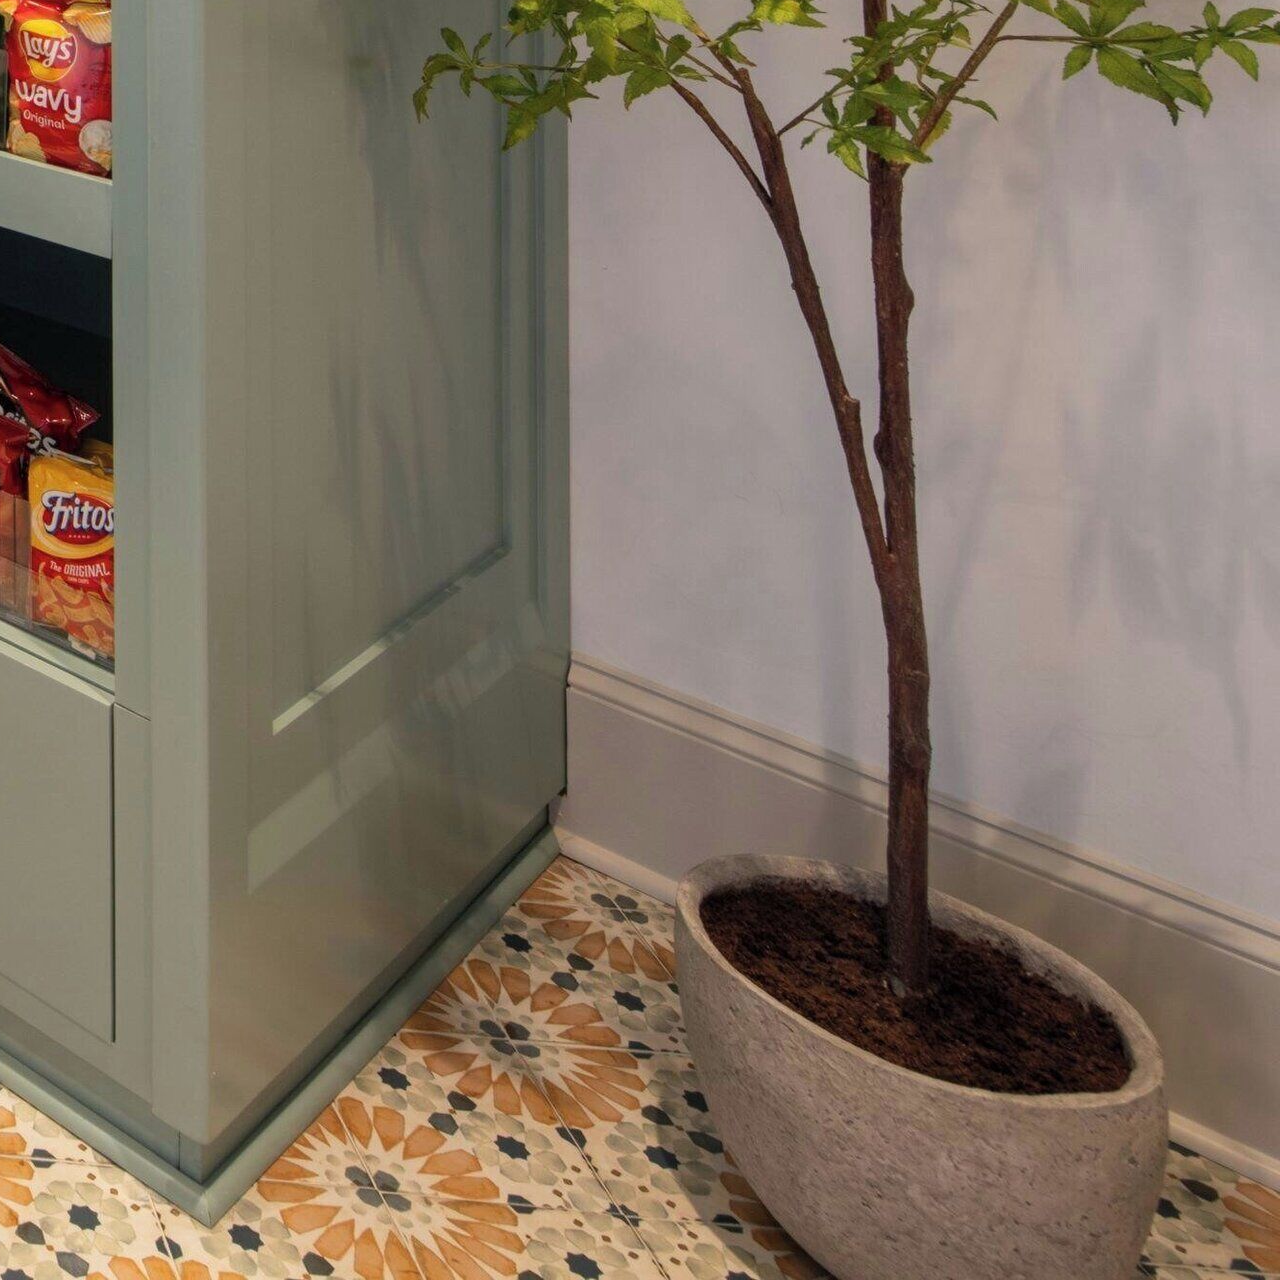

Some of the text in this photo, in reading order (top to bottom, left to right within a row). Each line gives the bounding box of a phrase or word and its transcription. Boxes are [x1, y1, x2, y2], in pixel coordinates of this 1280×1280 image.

[23, 30, 74, 67] Lay's
[14, 78, 83, 124] wavy
[23, 109, 66, 131] Original
[41, 489, 115, 534] Fritos
[49, 560, 112, 577] The ORIGINAL
